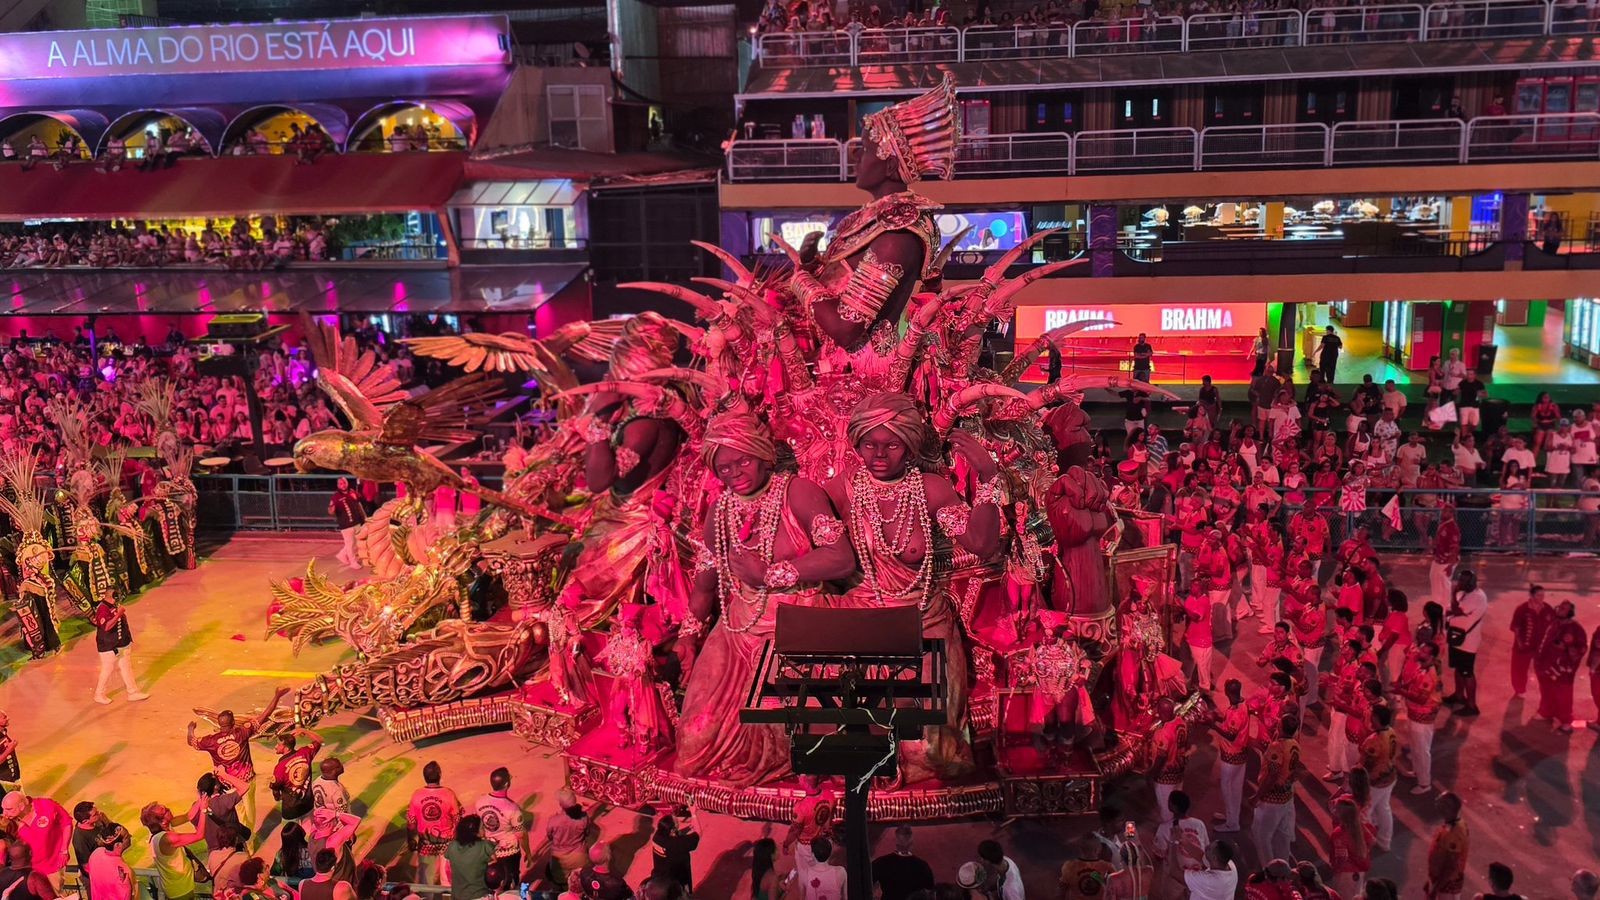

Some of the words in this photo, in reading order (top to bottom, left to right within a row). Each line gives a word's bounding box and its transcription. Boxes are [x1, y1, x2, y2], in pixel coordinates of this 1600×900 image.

[47, 40, 67, 67] A
[73, 37, 153, 67] ALMA
[158, 35, 204, 63] DO
[210, 33, 259, 62] RIO
[265, 24, 338, 60] ESTÁ
[344, 27, 415, 61] AQUI
[1161, 307, 1232, 331] BRAHMA
